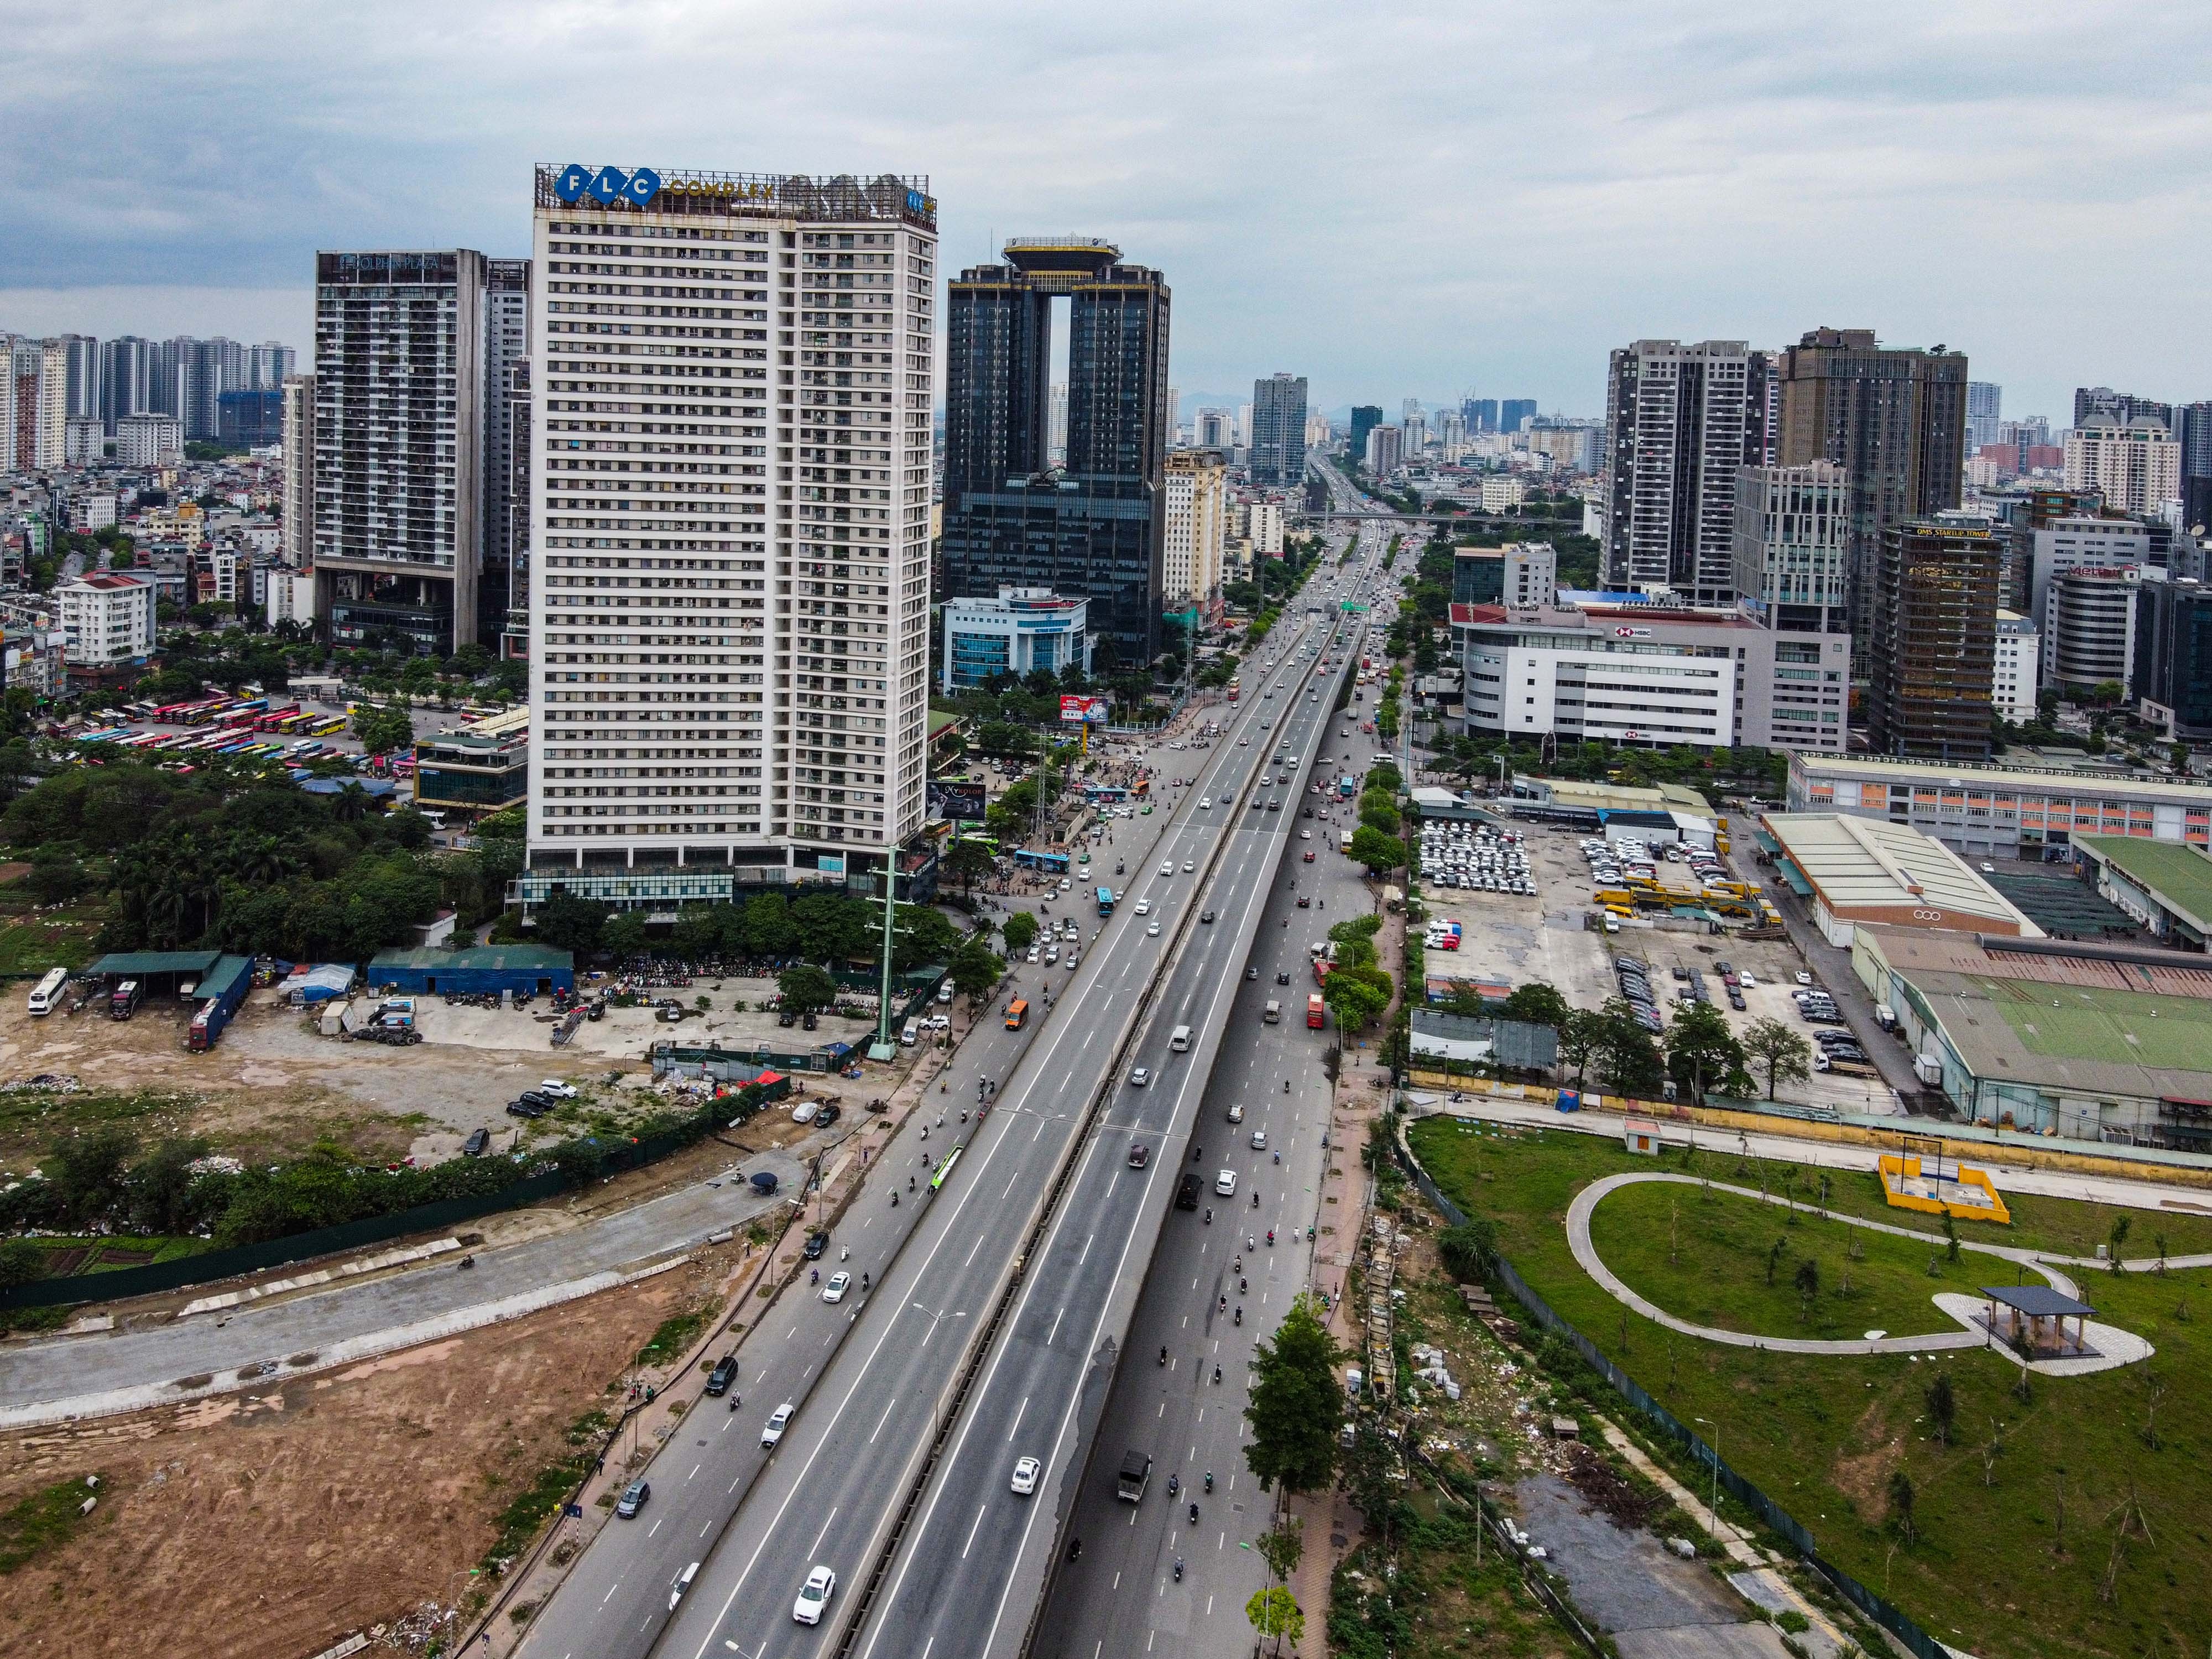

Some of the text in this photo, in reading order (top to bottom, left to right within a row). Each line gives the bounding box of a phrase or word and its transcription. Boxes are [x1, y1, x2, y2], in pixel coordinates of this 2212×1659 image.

[569, 175, 774, 199] FLC COMPLEX
[405, 257, 439, 269] PLAZA
